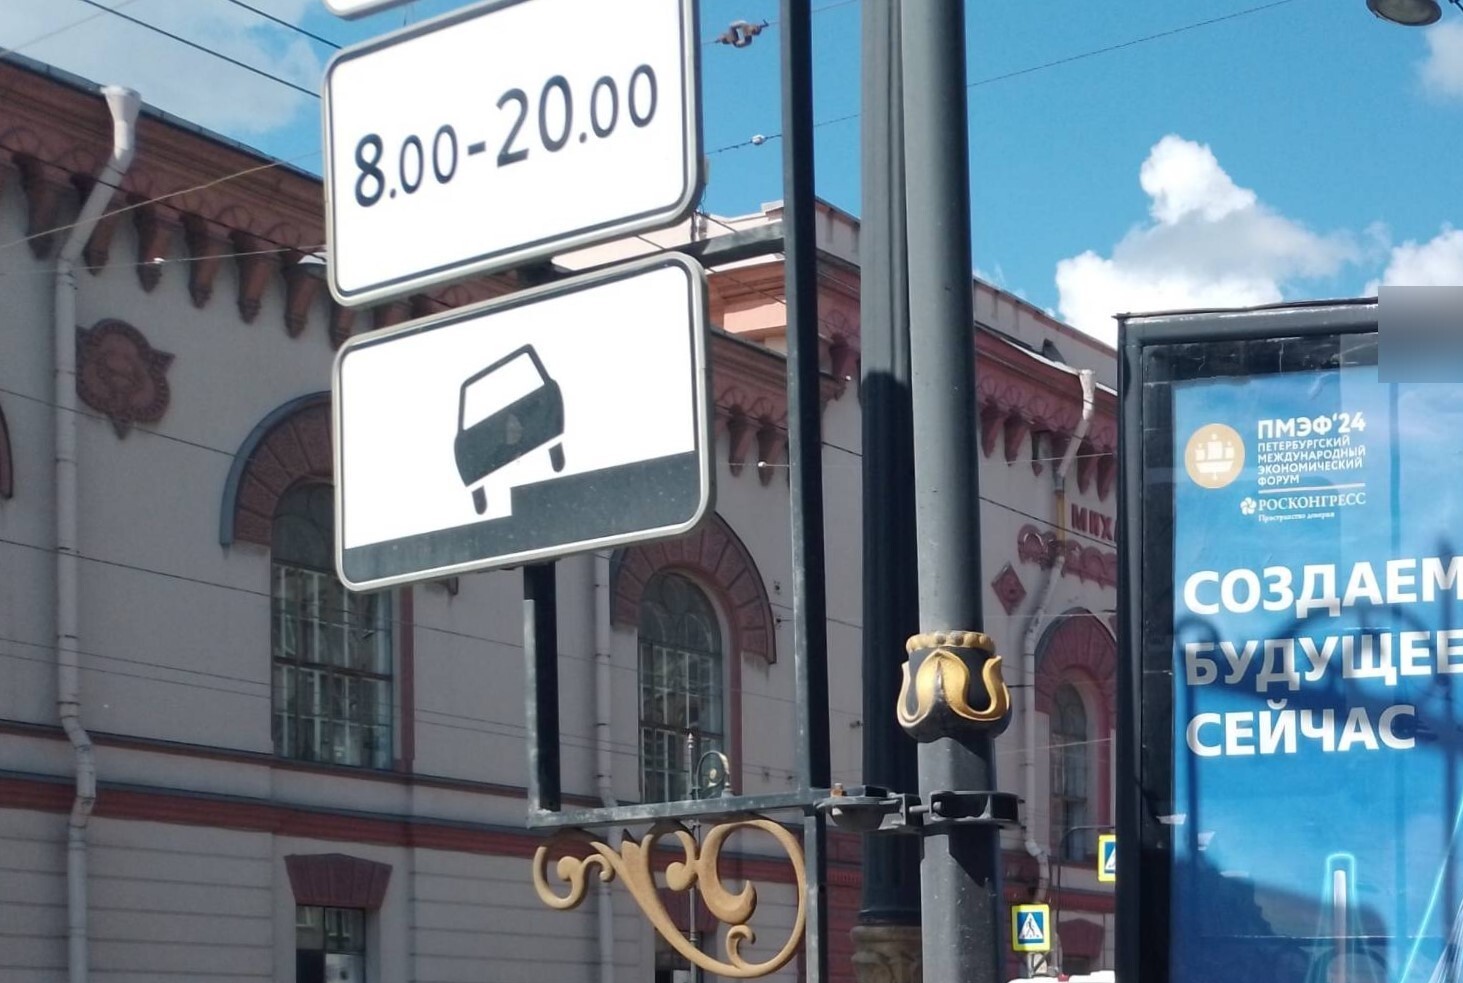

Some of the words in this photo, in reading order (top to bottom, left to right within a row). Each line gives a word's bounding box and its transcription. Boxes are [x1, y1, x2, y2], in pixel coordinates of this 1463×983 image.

[354, 64, 658, 207] 8.00-20.00
[1257, 434, 1350, 453] ПЕТЕРБУРГСКИЙ
[1257, 445, 1366, 464] МЕЖДУНАРОДНЫЙ
[1257, 456, 1363, 475] ЭКОНОМИЧЕСКИЙ
[1257, 474, 1300, 487] ФОРУМ
[1258, 492, 1366, 511] РОСКОНГРЕСС
[1071, 503, 1117, 542] МИХ
[1185, 698, 1416, 758] СЕЙЧАС
